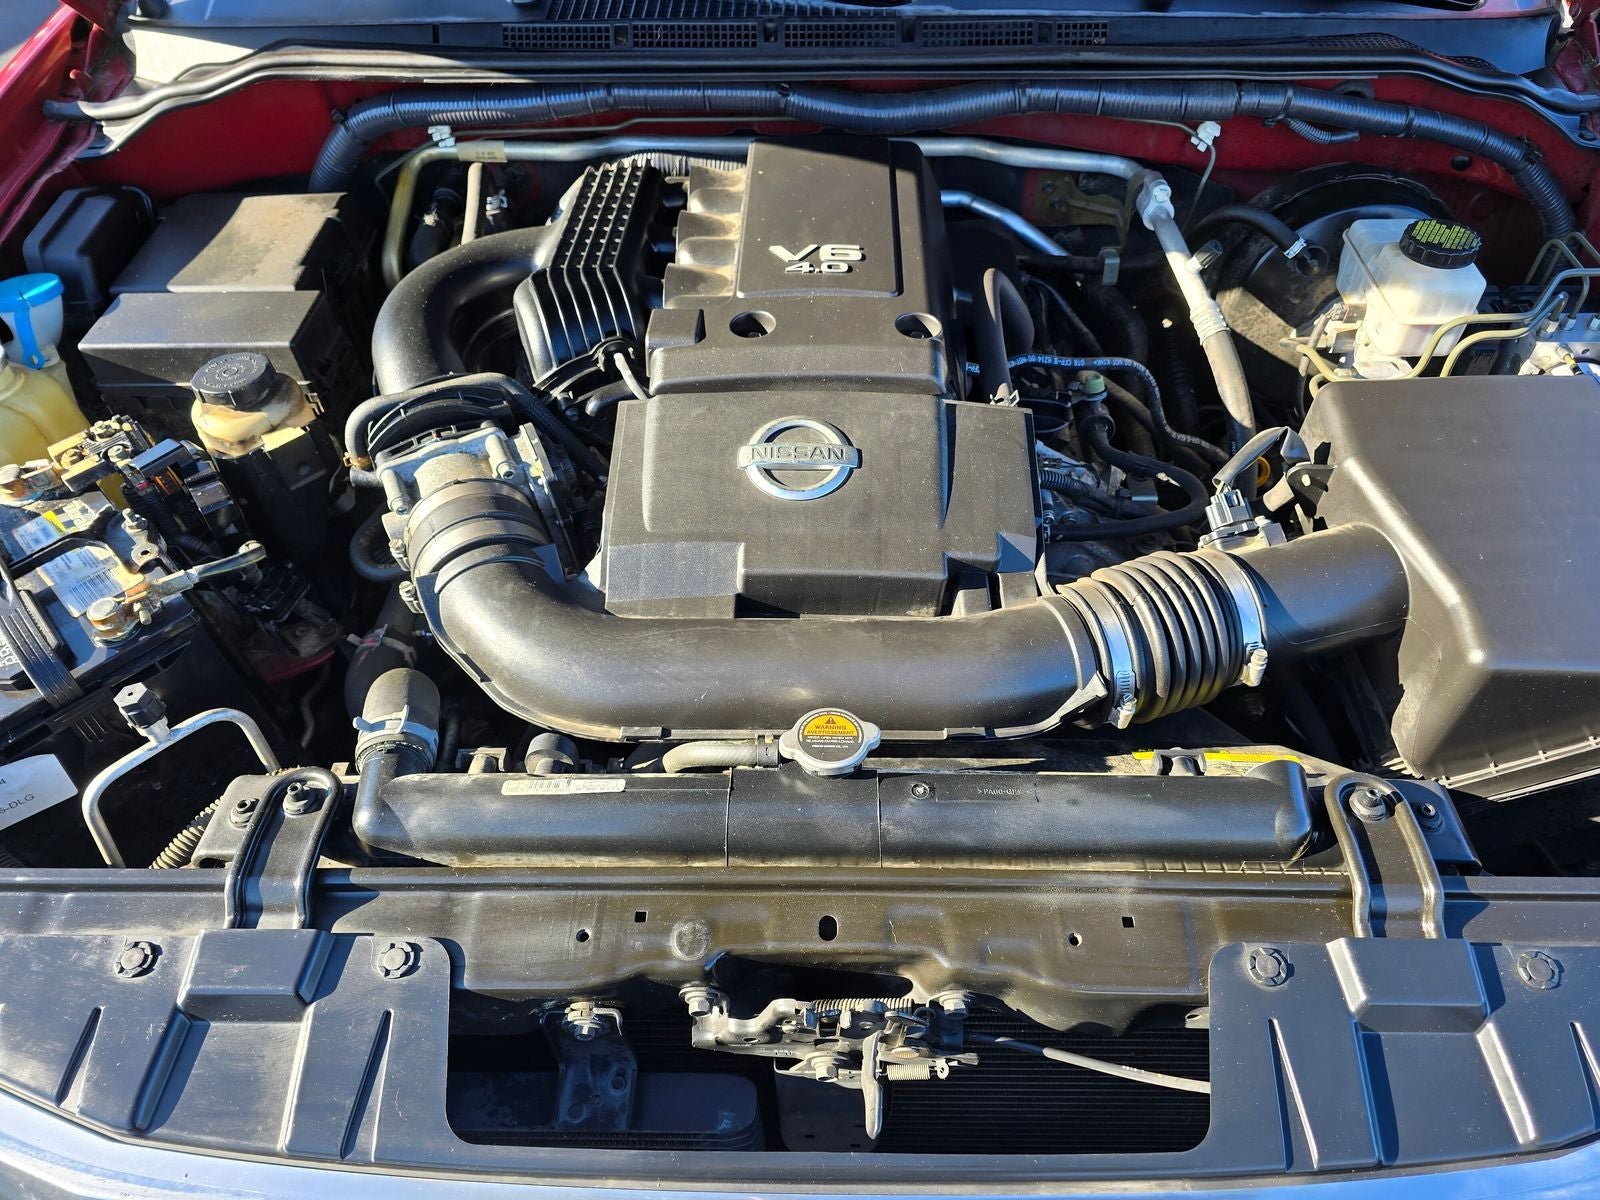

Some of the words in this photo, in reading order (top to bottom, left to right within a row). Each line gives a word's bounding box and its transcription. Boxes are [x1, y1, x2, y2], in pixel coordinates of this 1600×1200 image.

[768, 244, 863, 262] V6
[785, 261, 849, 274] 4.0
[751, 445, 846, 461] NISSAN
